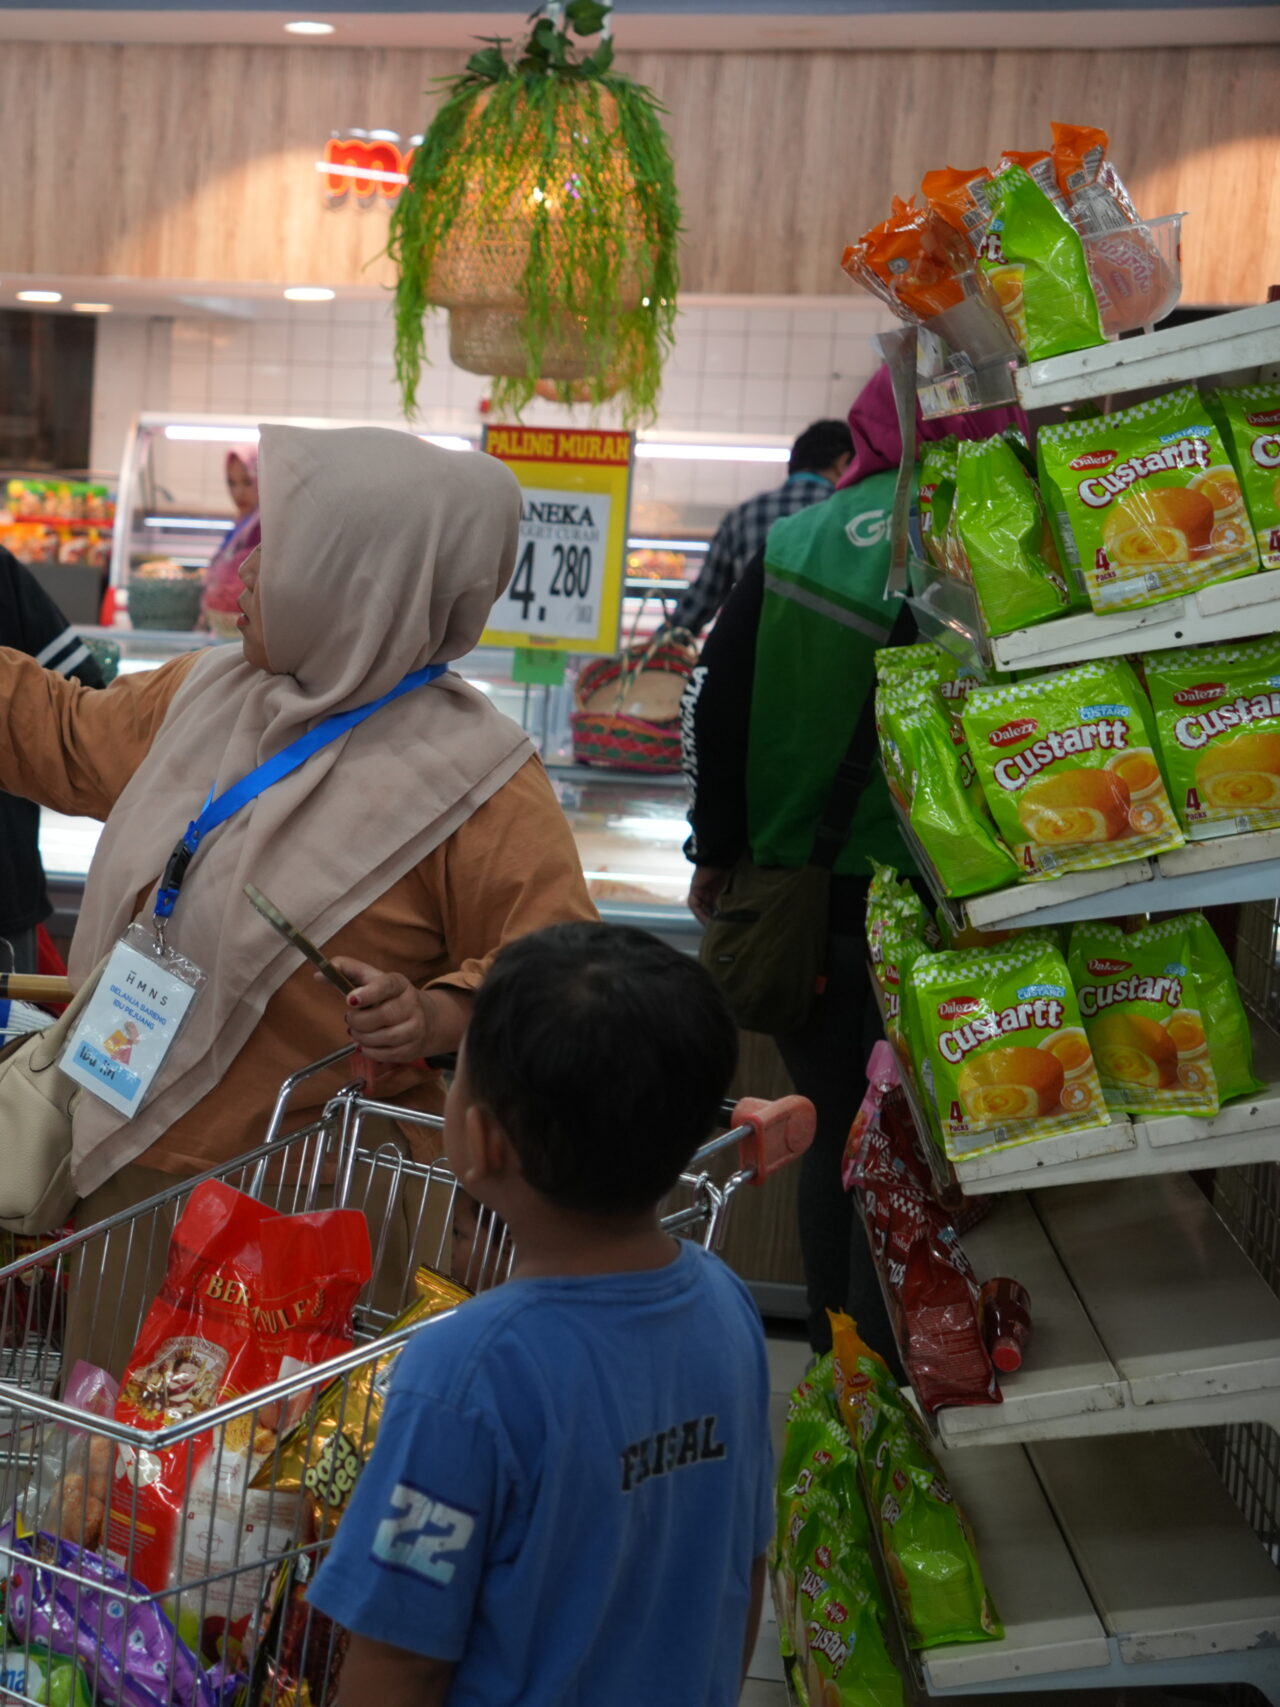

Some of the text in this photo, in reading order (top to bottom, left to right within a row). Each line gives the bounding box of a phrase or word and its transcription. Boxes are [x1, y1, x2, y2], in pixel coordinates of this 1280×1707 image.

[487, 430, 629, 461] PALING MURAH
[1078, 437, 1212, 510] Custartt
[550, 543, 591, 599] 280
[1096, 547, 1110, 571] 4
[1174, 686, 1223, 703] Dalezz
[989, 722, 1036, 744] Dalezz
[993, 718, 1130, 792] Custartt
[1186, 787, 1202, 812] 4
[1024, 846, 1036, 869] 4
[110, 984, 167, 1026] BELANJA BARENG
[123, 1005, 155, 1031] PEJUANG
[938, 998, 1064, 1064] Custartt
[949, 1101, 964, 1124] 4
[371, 1483, 476, 1586] 22
